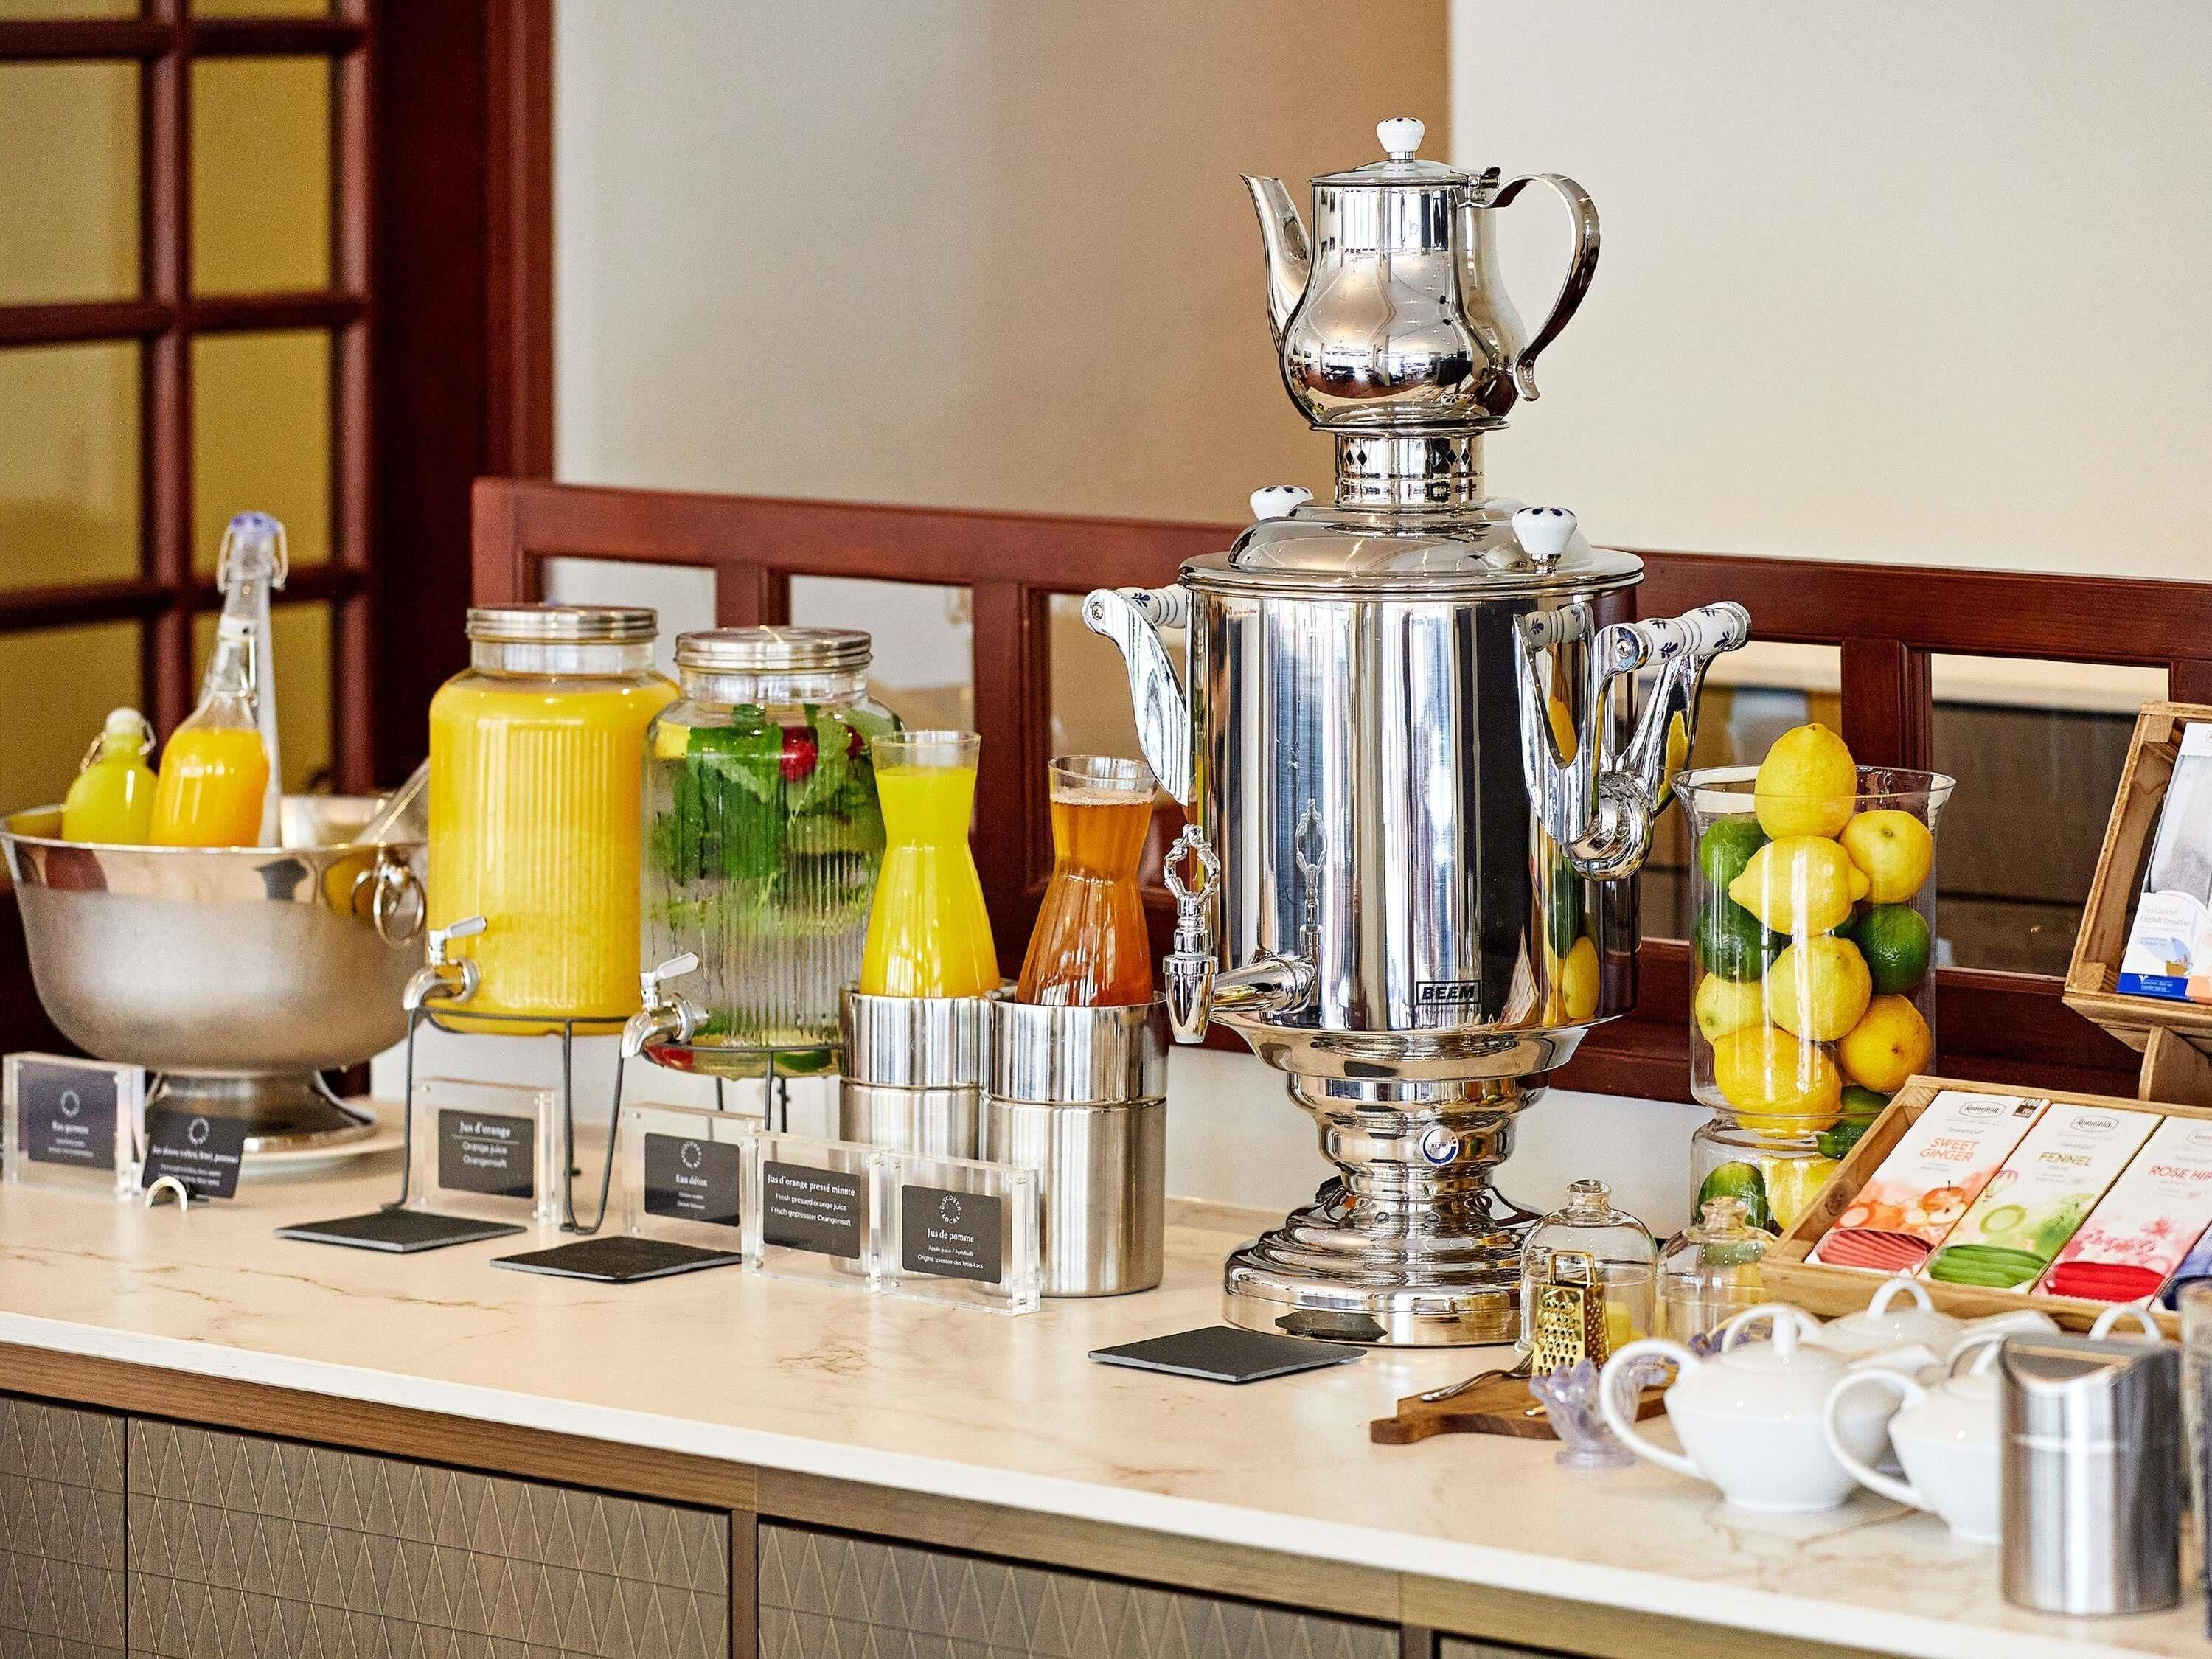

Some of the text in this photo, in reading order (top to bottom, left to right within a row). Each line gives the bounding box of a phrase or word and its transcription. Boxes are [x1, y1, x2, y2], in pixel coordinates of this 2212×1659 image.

[1422, 985, 1475, 1000] BEEM
[1930, 1138, 1980, 1151] SWEET
[1919, 1148, 1974, 1161] GINGER
[2038, 1151, 2093, 1166] FENNEL
[2148, 1164, 2189, 1178] ROSE
[675, 1173, 689, 1184] Eau
[768, 1174, 855, 1197] Jus d'orange pressé minute
[776, 1193, 847, 1211] Fresh pressed orange juice
[939, 1195, 961, 1211] DISCOVER
[817, 1214, 852, 1227] Orangensaft
[941, 1213, 960, 1224] LOCAL
[928, 1228, 974, 1242] Jus de pomme
